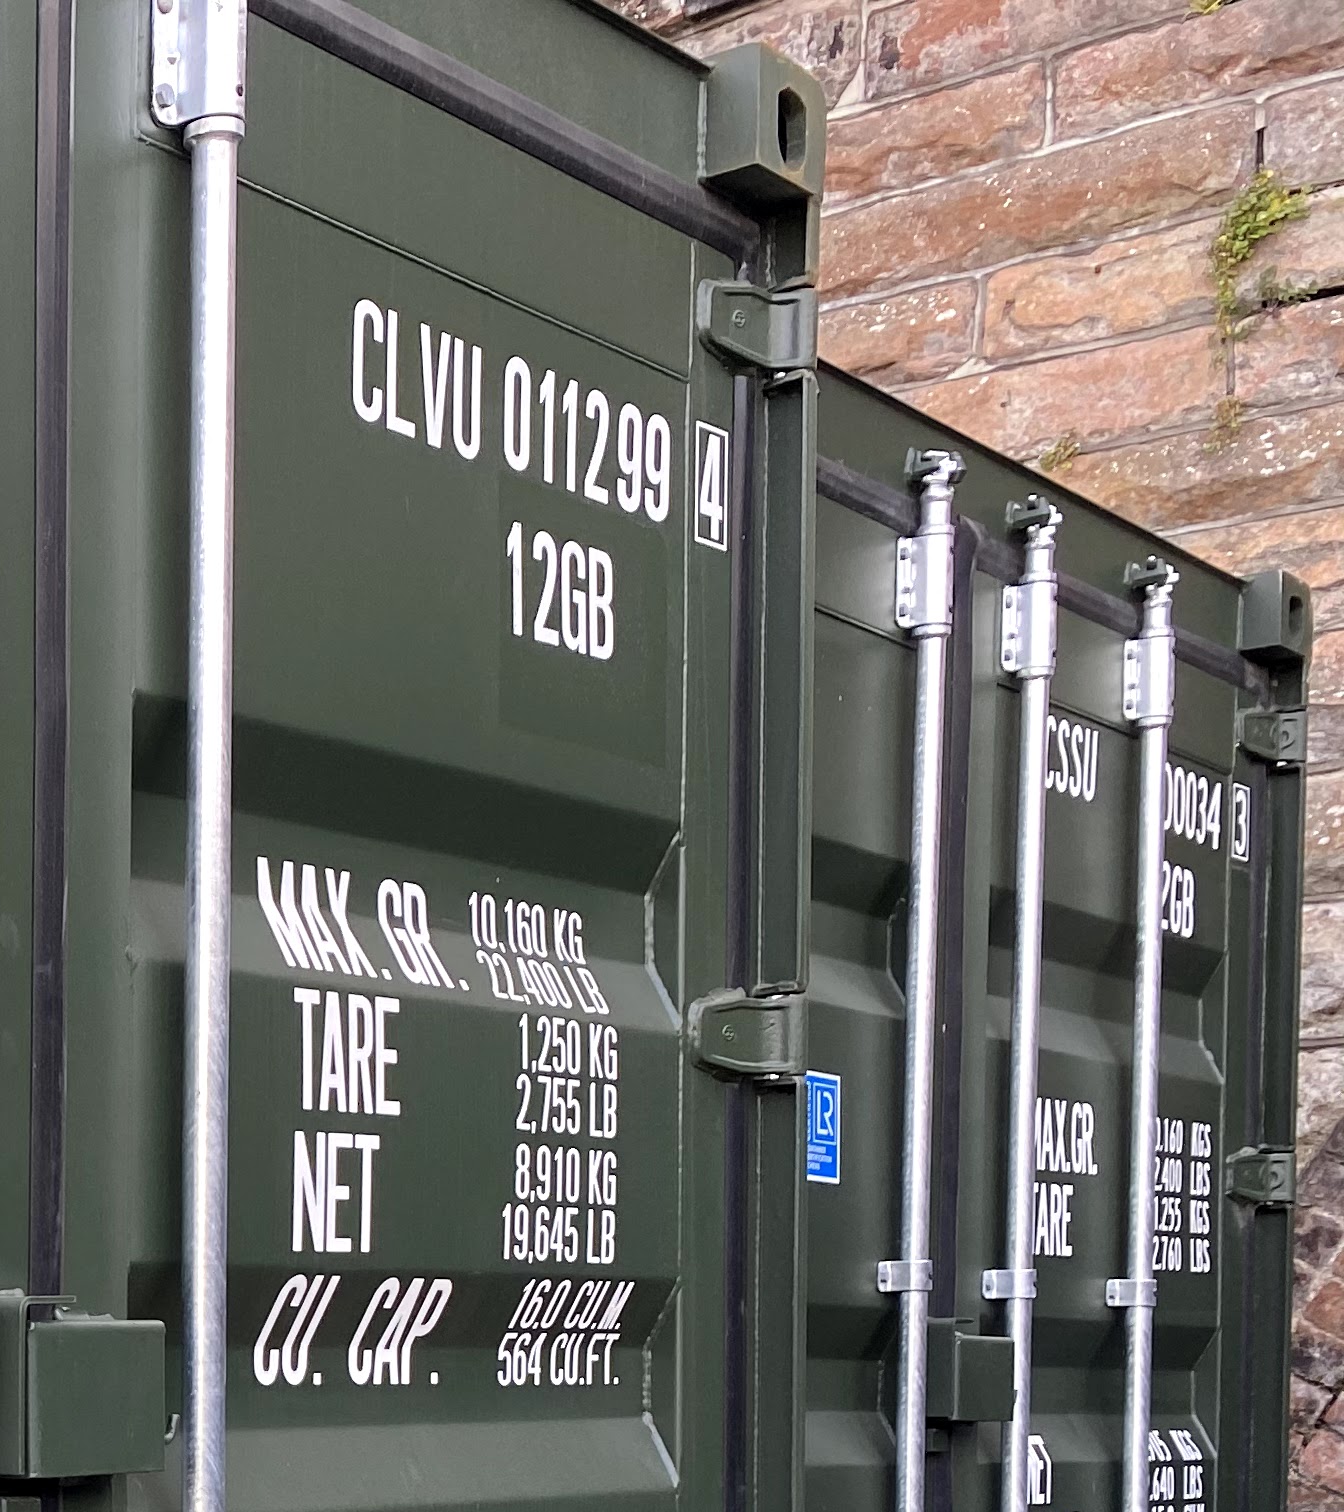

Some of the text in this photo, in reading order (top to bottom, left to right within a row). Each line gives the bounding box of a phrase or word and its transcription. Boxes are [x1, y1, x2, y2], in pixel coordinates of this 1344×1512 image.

[352, 298, 724, 542] CLVU 011299 4
[506, 520, 613, 660] 12GB
[1234, 788, 1249, 856] 3
[257, 856, 393, 980] MAX.
[377, 878, 470, 991] GR.
[553, 908, 587, 965] KG
[563, 966, 609, 1015] LB
[293, 986, 618, 1116] TARE 1,250 KG
[516, 1073, 617, 1139] 2,755 LB
[1190, 1121, 1212, 1158] KGS
[292, 1131, 617, 1253] NET 8,910 KG
[1189, 1161, 1211, 1197] LBS
[502, 1202, 616, 1264] 19,645 LB
[1189, 1199, 1211, 1235] KGS
[1189, 1237, 1211, 1273] LBS
[253, 1274, 635, 1386] CU. CAP. 16.0 CU.M.
[497, 1332, 621, 1386] 564 CU.FT.
[1183, 1465, 1203, 1500] LBS
